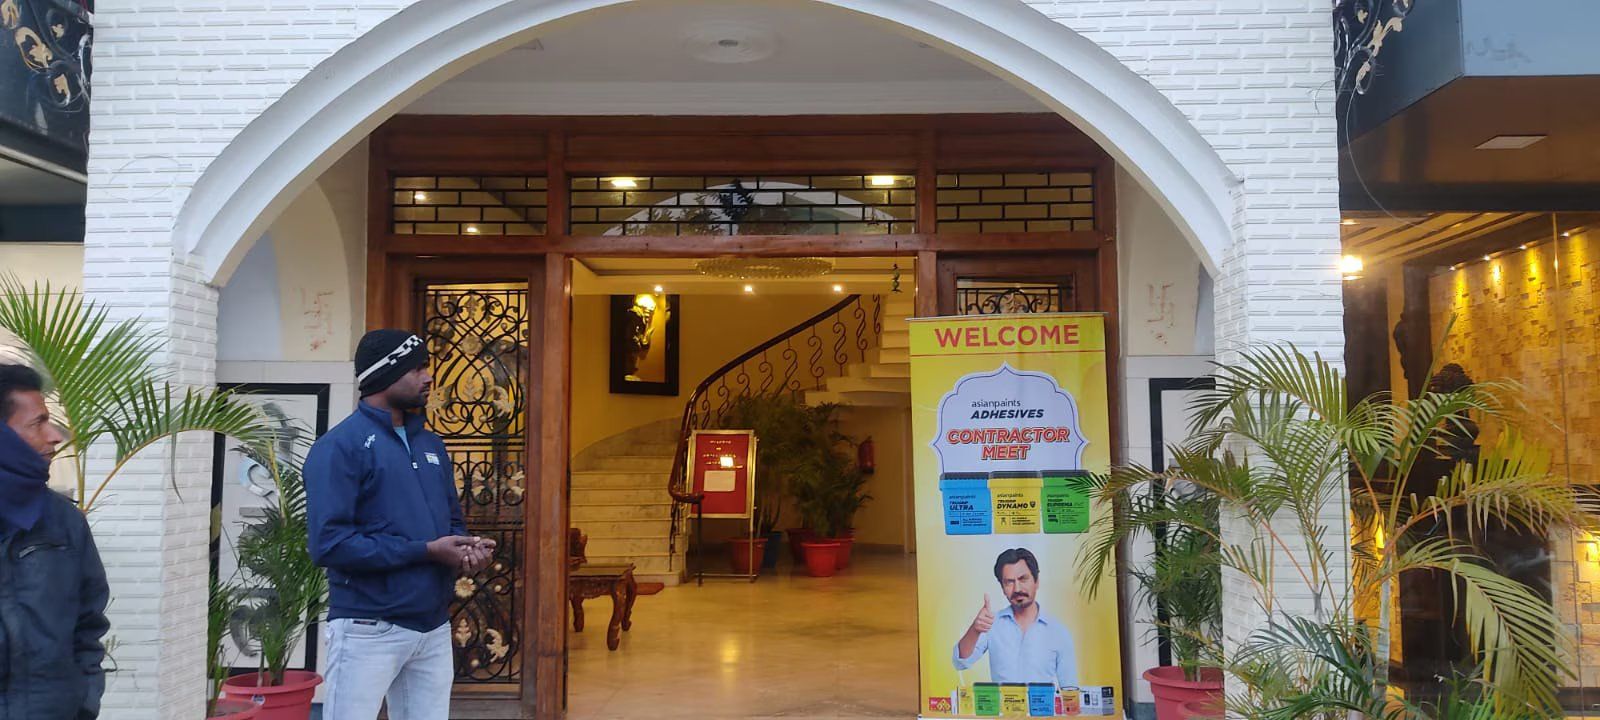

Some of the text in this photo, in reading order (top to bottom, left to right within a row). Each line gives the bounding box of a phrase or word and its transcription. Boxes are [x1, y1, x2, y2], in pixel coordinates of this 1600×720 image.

[934, 324, 1080, 348] WELCOME
[971, 398, 1021, 408] asianpaints
[970, 409, 1044, 419] ADHESIVES
[947, 426, 1070, 444] CONTRACTOR
[981, 444, 1031, 461] MEET
